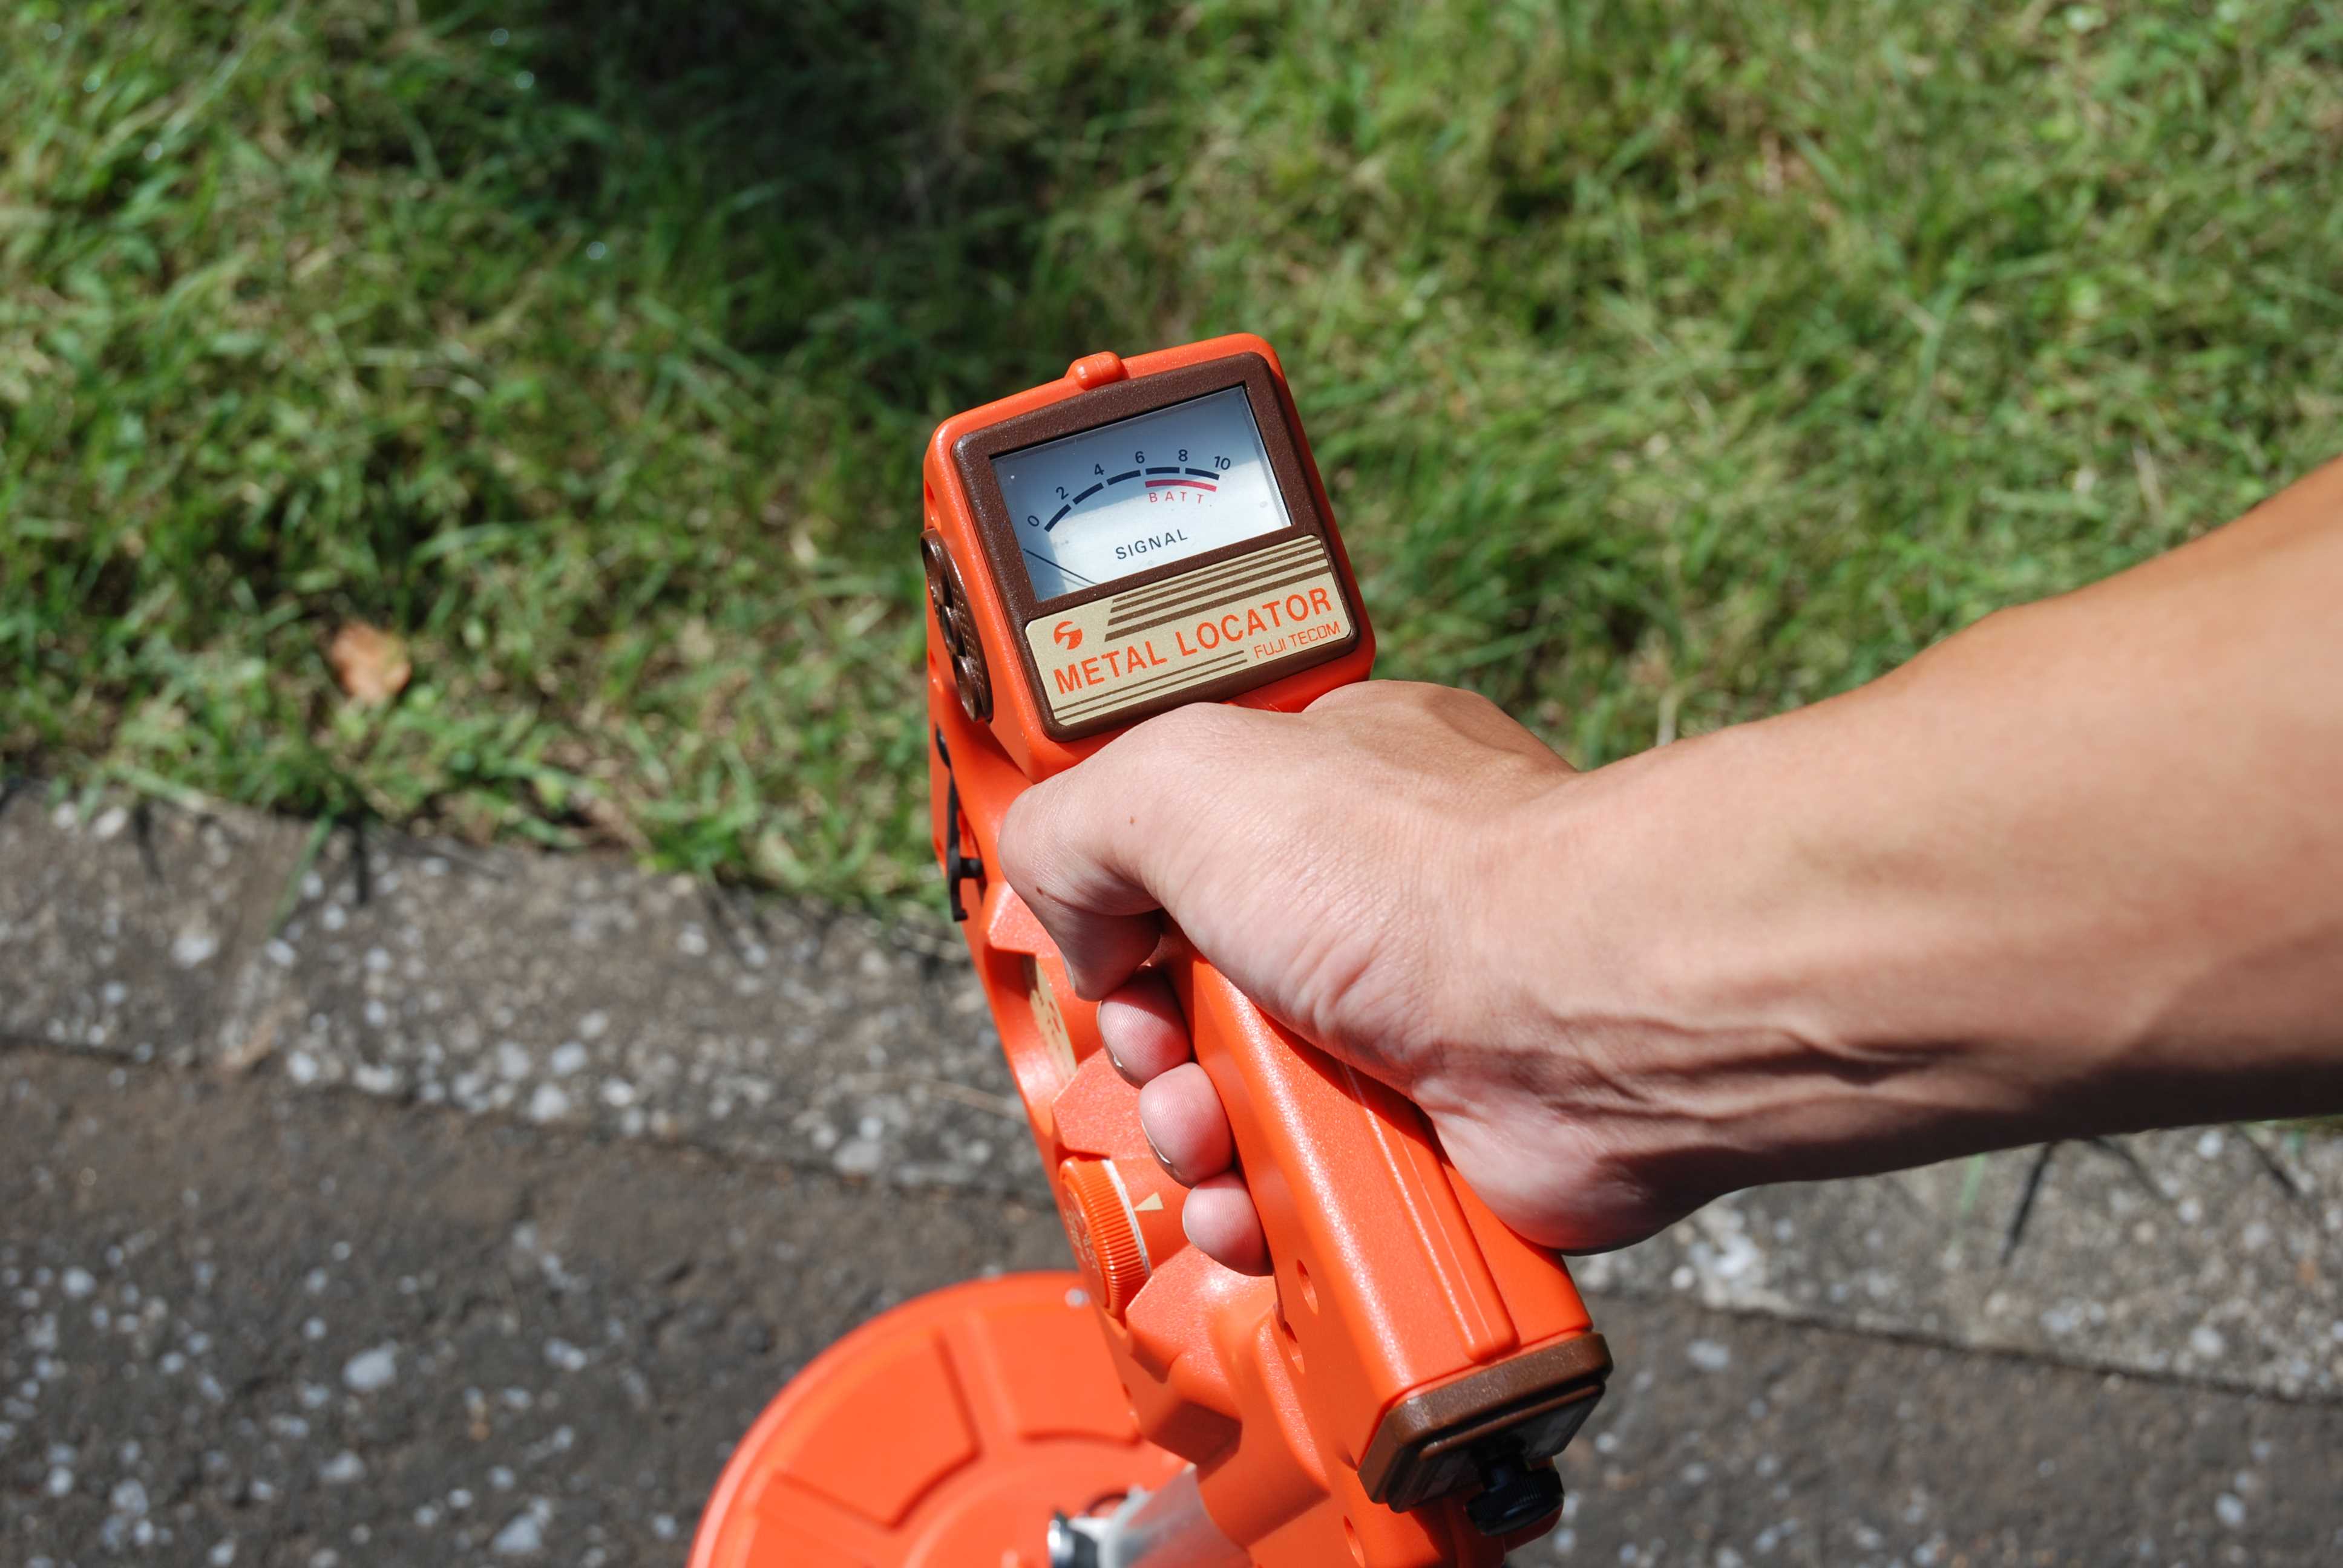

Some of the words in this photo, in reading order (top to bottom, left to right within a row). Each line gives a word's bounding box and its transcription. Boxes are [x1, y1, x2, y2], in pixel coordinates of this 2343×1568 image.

[1027, 515, 1040, 528] 0
[1055, 486, 1069, 500] 2
[1093, 463, 1105, 477] 4
[1135, 451, 1145, 464] 6
[1178, 449, 1189, 462] 8
[1213, 456, 1231, 471] 10
[1149, 491, 1205, 505] BATT
[1115, 528, 1188, 561] SIGNAL
[1053, 641, 1168, 694] METAL
[1175, 587, 1332, 656] LOCATOR
[1253, 638, 1288, 659] FUJI
[1288, 621, 1342, 647] TECOM
